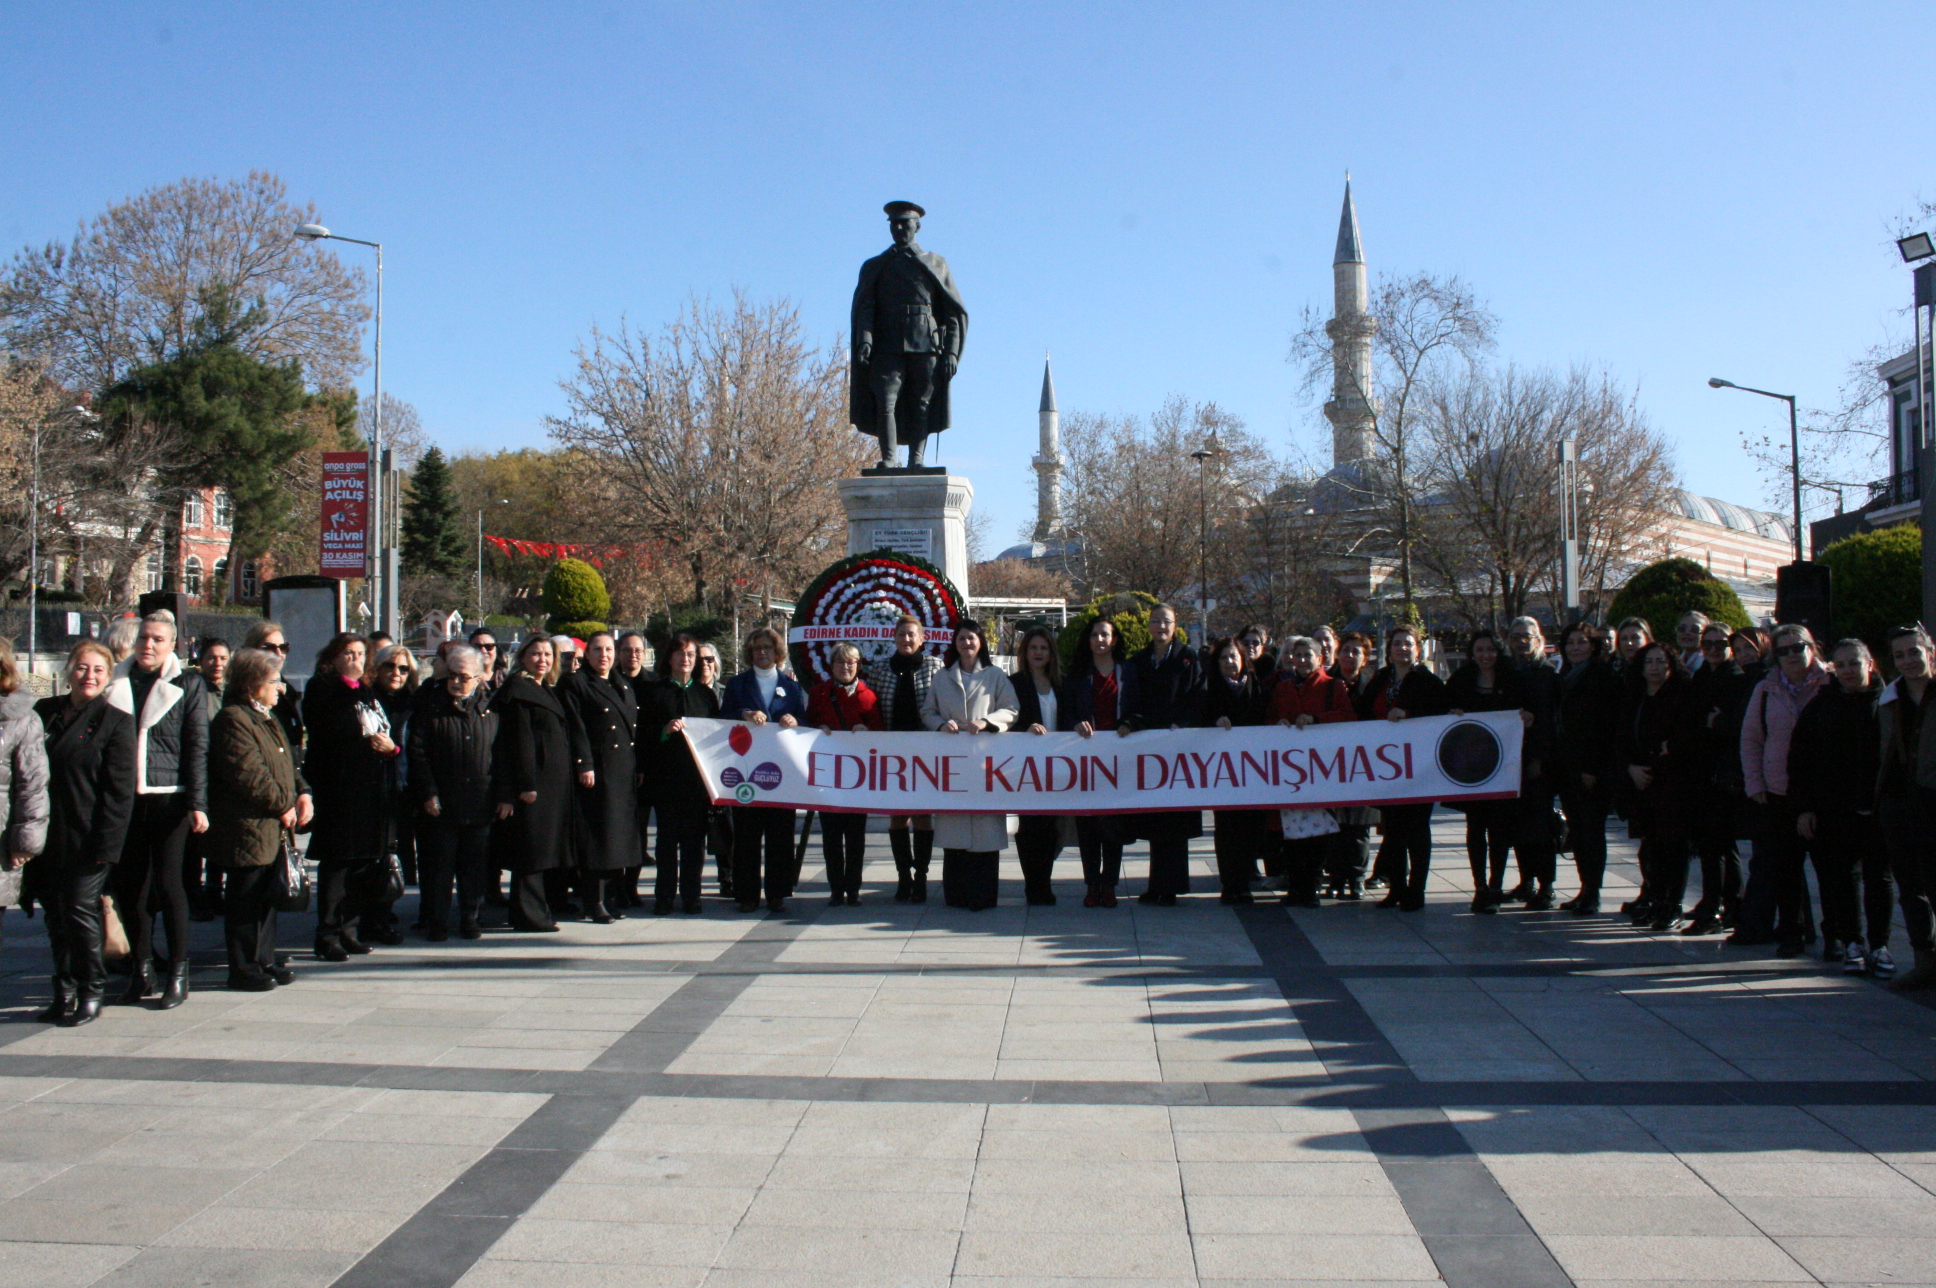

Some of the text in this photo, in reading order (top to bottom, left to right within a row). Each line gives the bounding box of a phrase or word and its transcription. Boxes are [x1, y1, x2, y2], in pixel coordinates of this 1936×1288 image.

[324, 462, 366, 472] anpa gross
[324, 477, 365, 489] BÜYÜK
[324, 490, 365, 502] AÇILIŞ
[323, 529, 363, 541] SİLİVRİ
[322, 552, 364, 560] 30 KASIM
[803, 626, 841, 639] EDİRNE
[843, 627, 879, 638] KADIN
[807, 743, 1414, 793] EDİRNE KADIN DAYANIŞMASI
